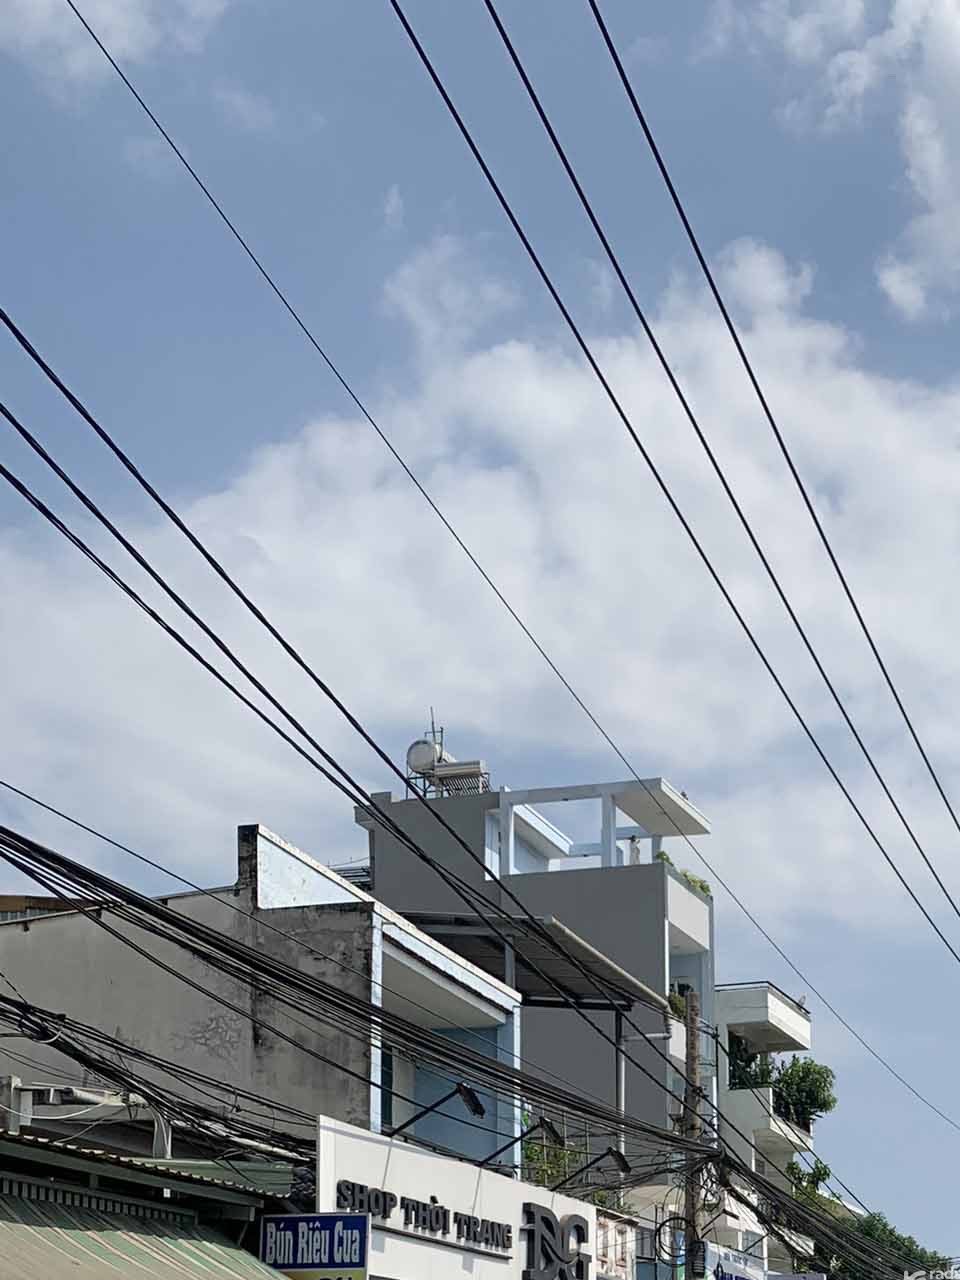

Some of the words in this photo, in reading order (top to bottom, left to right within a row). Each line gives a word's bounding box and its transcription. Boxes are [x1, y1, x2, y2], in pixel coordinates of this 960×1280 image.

[265, 1222, 293, 1264] Bún
[297, 1221, 330, 1264] Riêu
[333, 1220, 360, 1263] Cua
[336, 1179, 397, 1219] SHOP
[454, 1211, 512, 1249] TRANG
